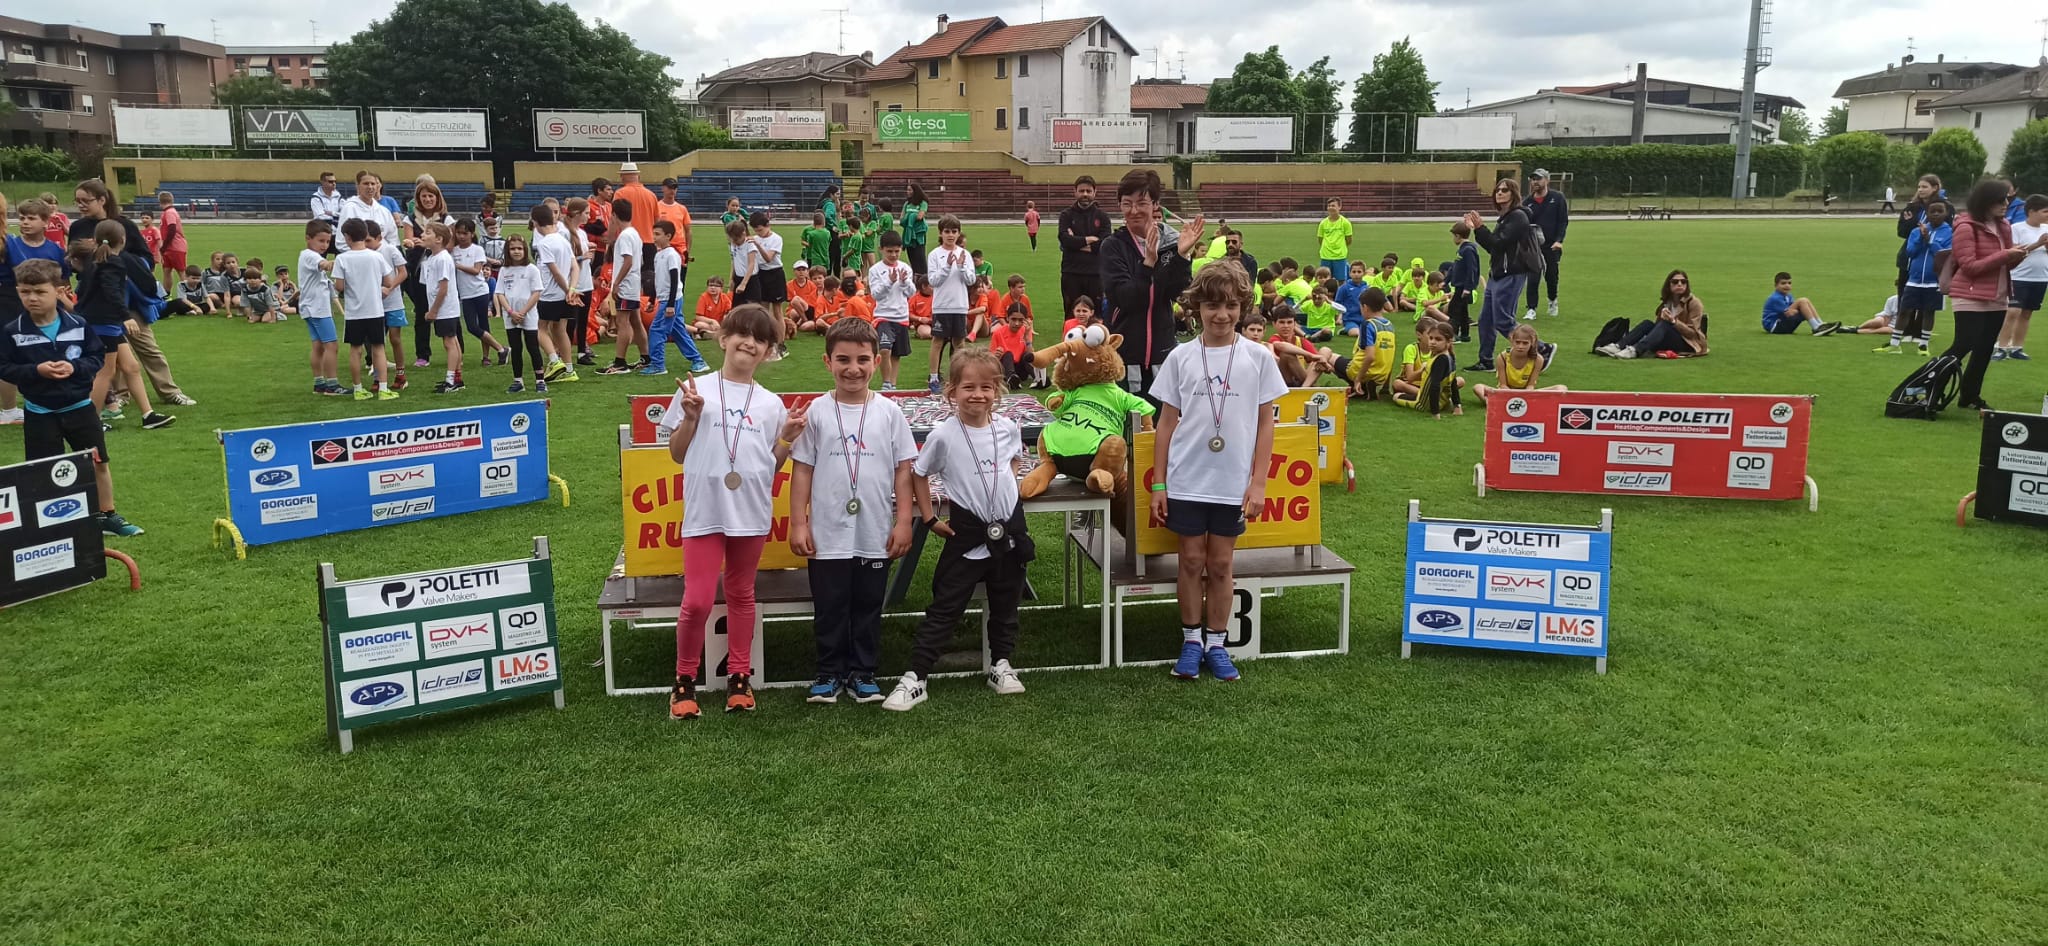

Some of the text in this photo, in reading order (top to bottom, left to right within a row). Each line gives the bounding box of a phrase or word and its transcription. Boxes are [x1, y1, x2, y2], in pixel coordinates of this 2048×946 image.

[248, 111, 308, 131] VTA
[907, 115, 947, 129] te-sa
[572, 124, 636, 135] SCIROCCO
[1061, 412, 1107, 435] DVK
[1596, 409, 1730, 424] CARLO POLETTI
[1614, 424, 1711, 433] HeatingComponents&Design
[351, 423, 480, 449] CARLO POLETTI
[371, 441, 465, 457] HeatingComponents&Design
[1618, 446, 1663, 456] DVK
[1511, 453, 1558, 462] BORGOFIL
[1736, 456, 1765, 471] QD
[380, 469, 424, 483] DVK
[486, 465, 511, 480] QD
[1619, 472, 1668, 485] idral
[48, 501, 77, 515] APS
[262, 496, 316, 510] BORGOFIL
[387, 497, 434, 515] idral
[1487, 530, 1560, 548] POLETTI
[15, 543, 72, 563] BORGOFIL
[1487, 546, 1537, 557] Valve Makers
[1419, 567, 1475, 579] BORGOFIL
[420, 569, 500, 594] POLETTI
[1491, 575, 1545, 589] DVK
[1563, 575, 1592, 591] QD
[1491, 585, 1515, 593] system
[422, 592, 478, 606] Valve Makers
[508, 611, 537, 628] QD
[1422, 613, 1455, 625] APS
[1477, 617, 1517, 630] idral
[429, 623, 488, 641] DVK
[1545, 616, 1595, 637] LMS
[345, 630, 413, 649] BORGOFIL
[430, 639, 457, 649] system
[1545, 635, 1595, 644] MECATRONIC
[499, 653, 549, 678] LMS
[421, 671, 464, 690] idral
[501, 672, 549, 685] MECATRONIC
[358, 685, 398, 703] APS
